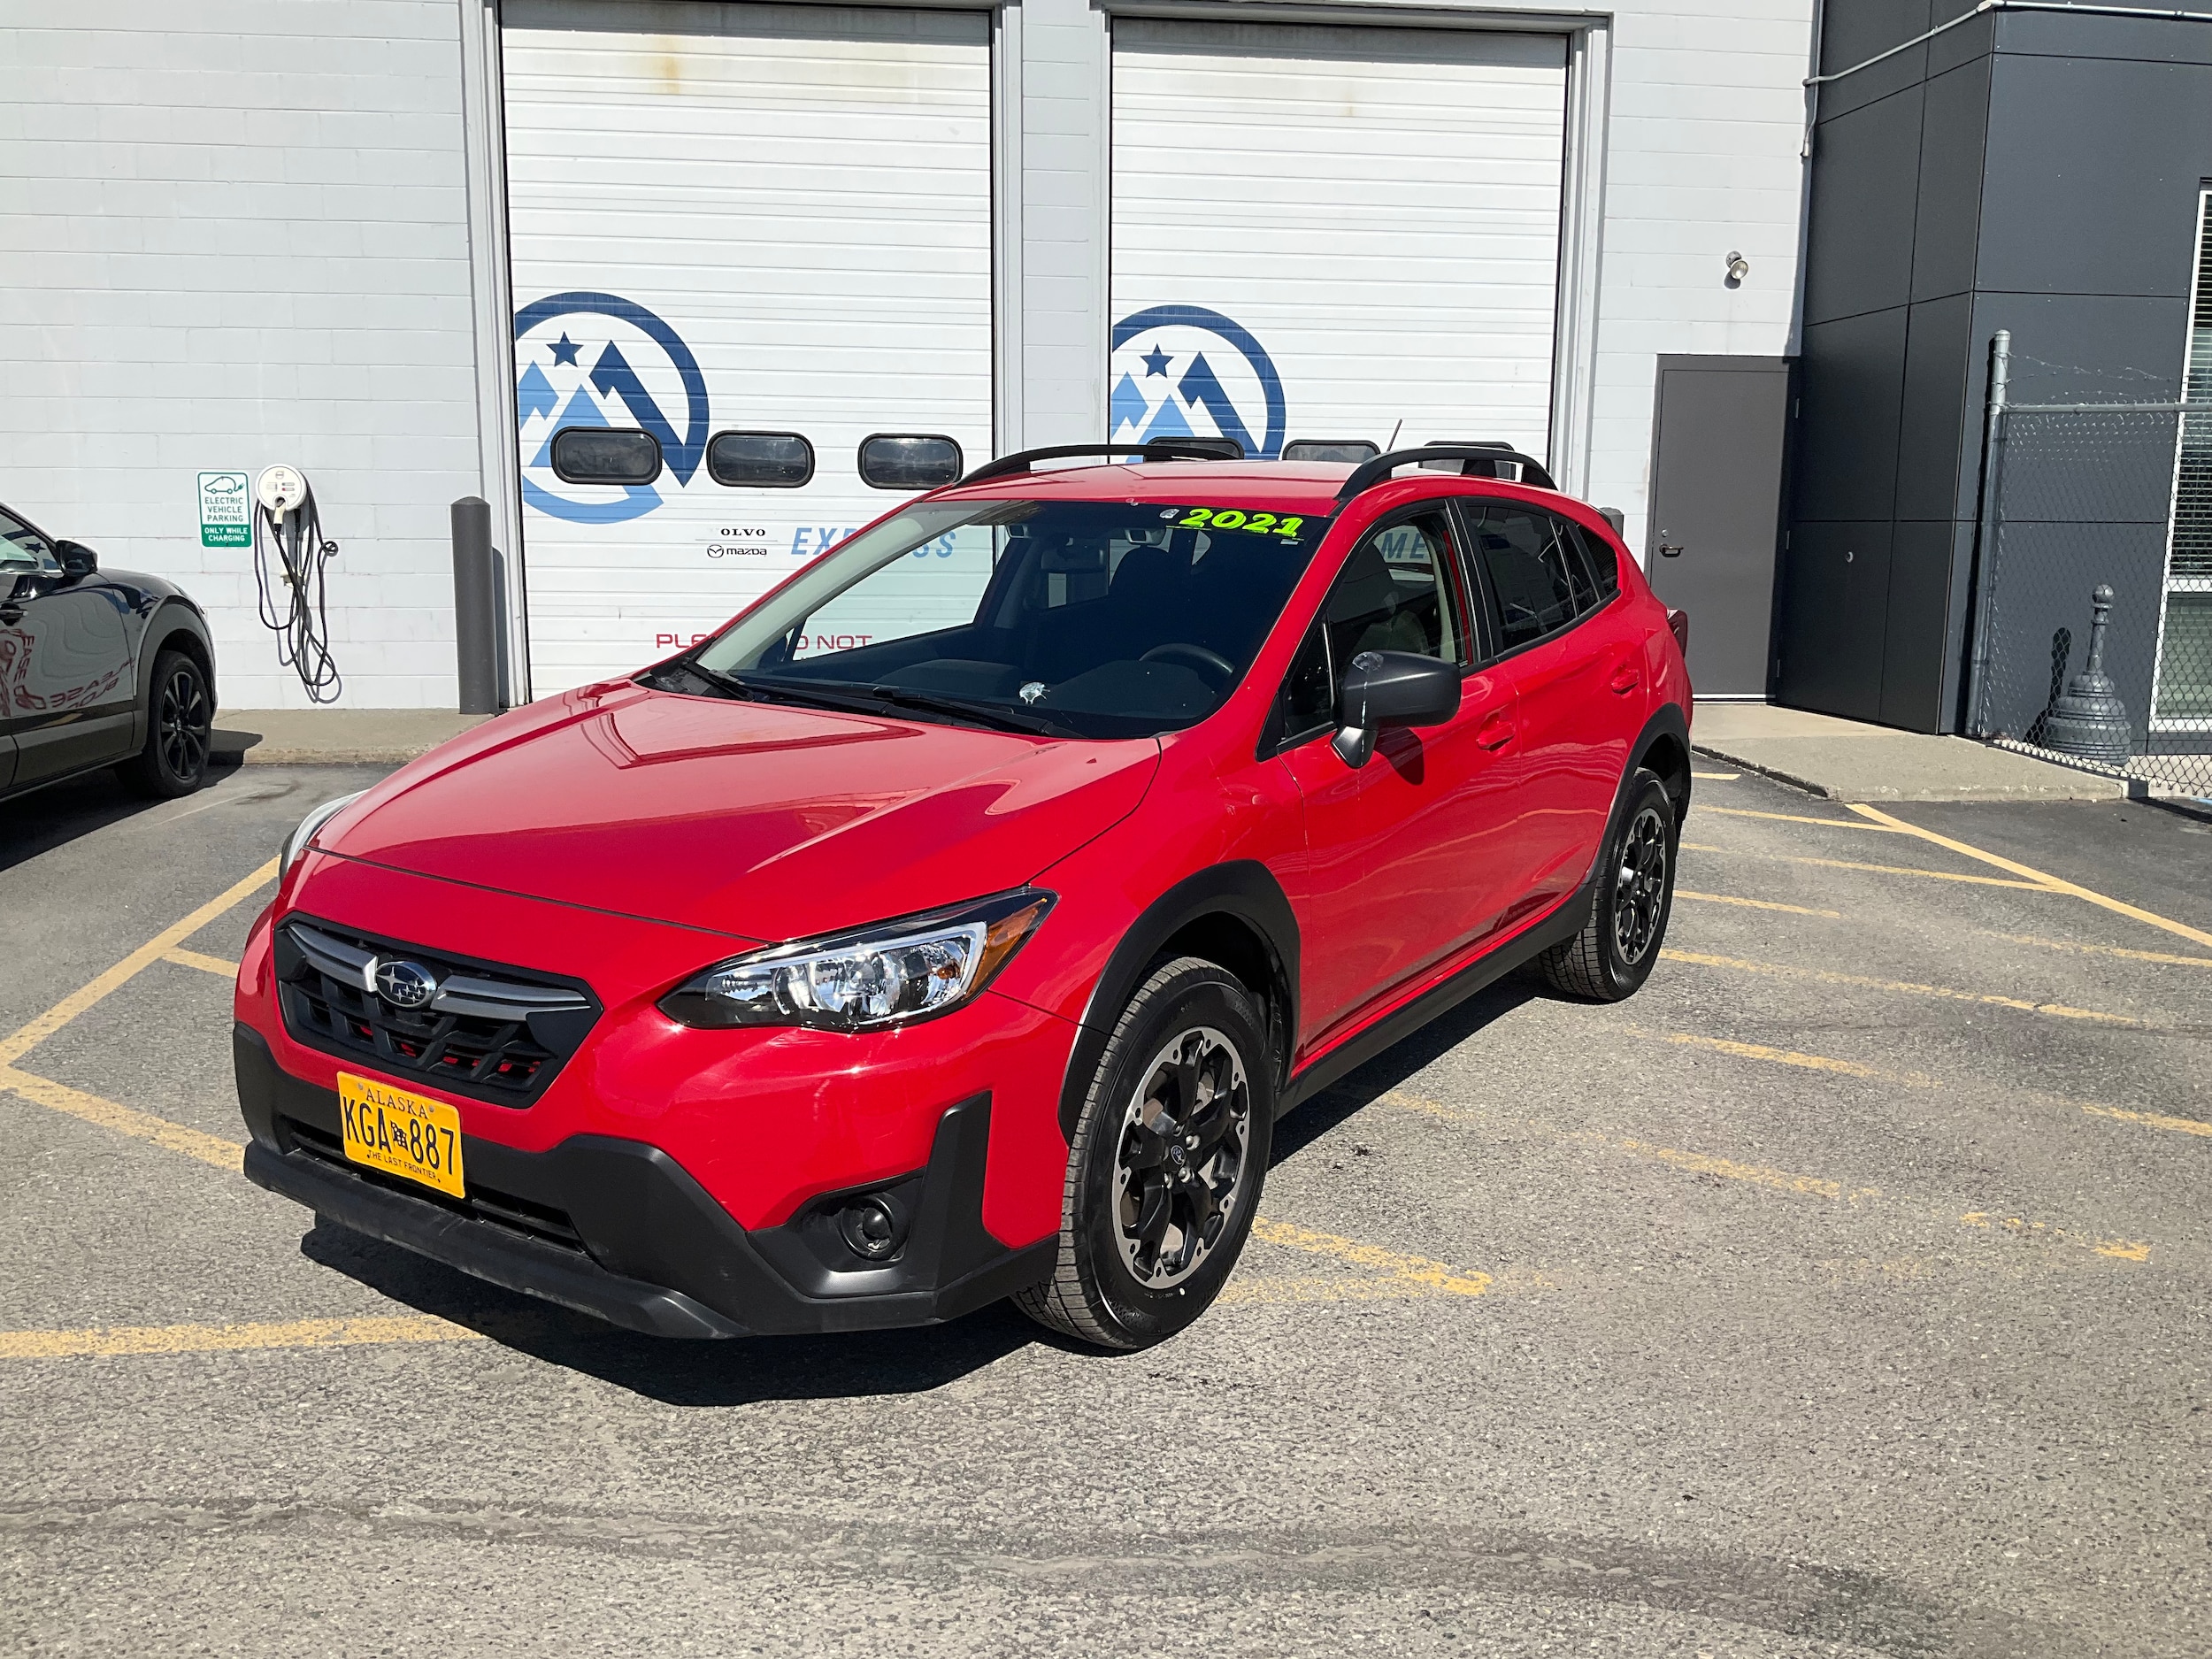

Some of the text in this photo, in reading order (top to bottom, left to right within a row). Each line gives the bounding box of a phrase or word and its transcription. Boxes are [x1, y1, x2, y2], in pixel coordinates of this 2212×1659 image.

[1179, 508, 1304, 538] 2021
[817, 635, 872, 649] NOT
[365, 1087, 429, 1120] ALASKA
[342, 1096, 454, 1176] KGA 887
[368, 1149, 437, 1180] THE LAST FRONTIER
